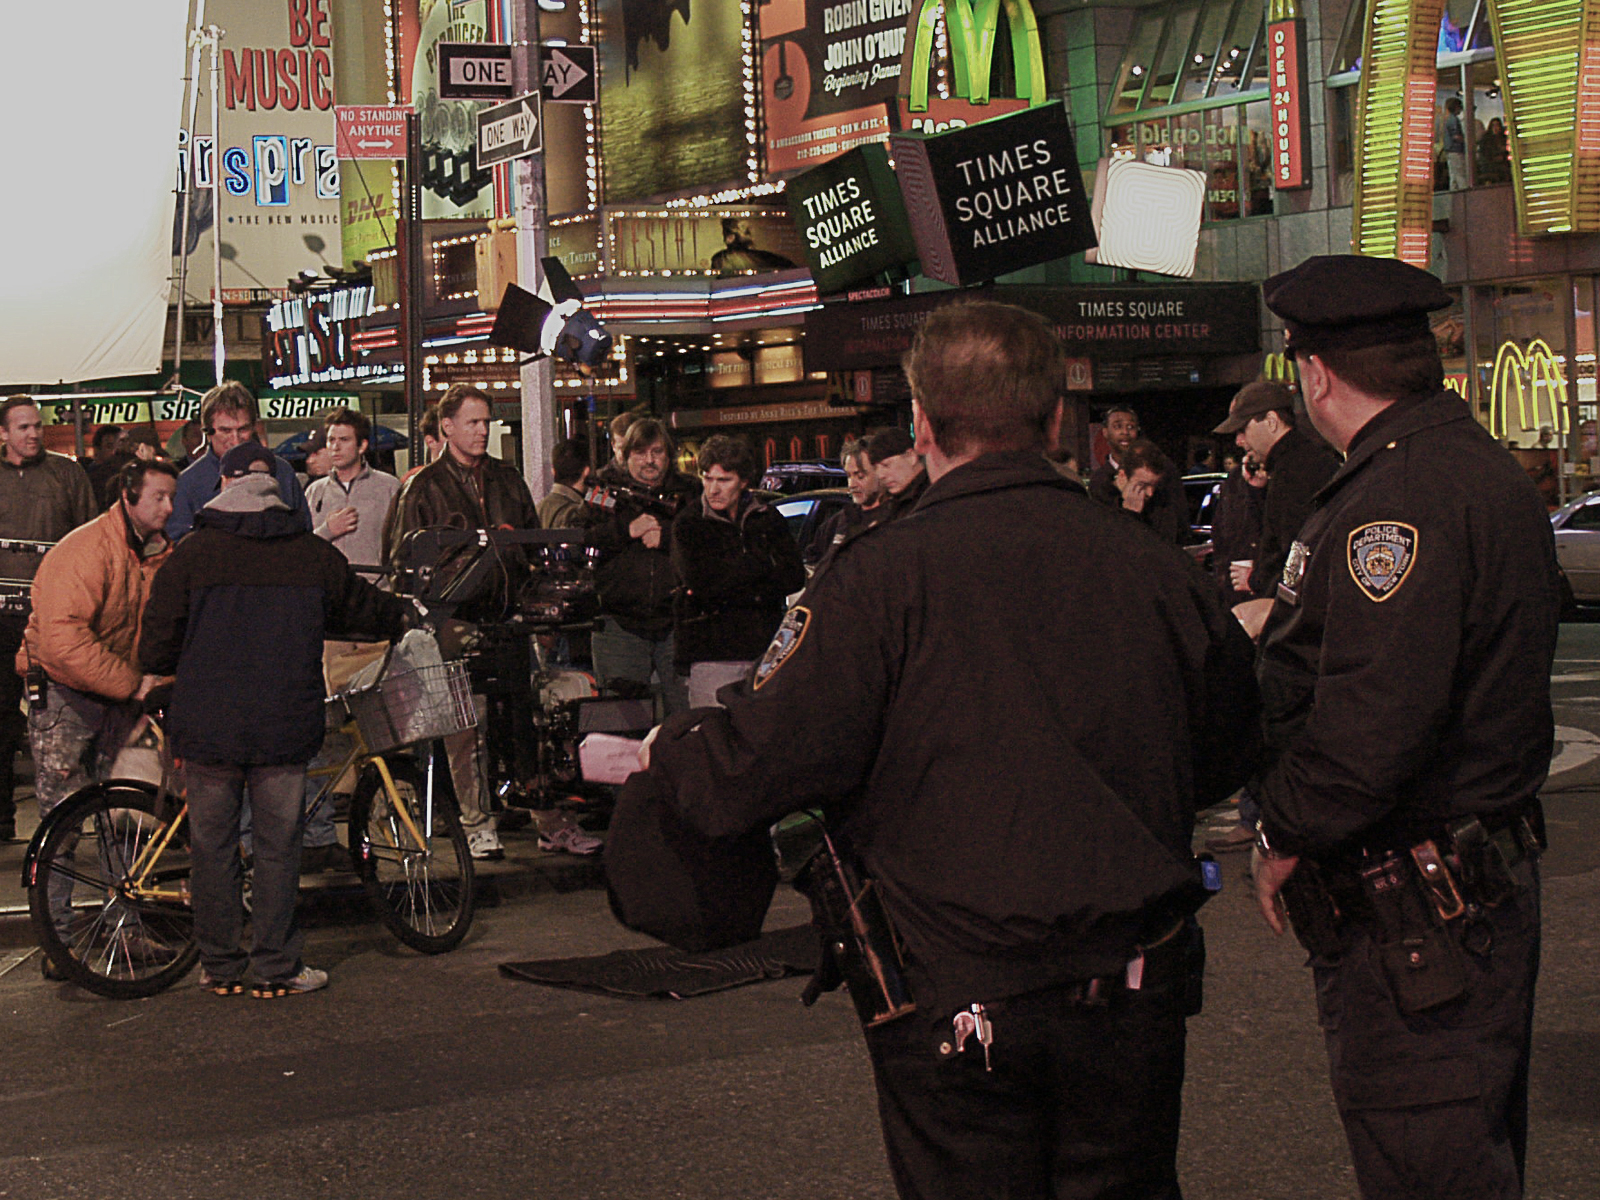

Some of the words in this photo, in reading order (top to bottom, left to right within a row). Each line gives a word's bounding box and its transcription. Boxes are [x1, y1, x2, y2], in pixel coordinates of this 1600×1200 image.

[288, 0, 332, 47] BE
[824, 0, 867, 34] ROBIN
[425, 22, 487, 74] PRODUCER
[824, 37, 863, 71] JOHN
[1274, 30, 1287, 87] OPEN
[222, 47, 333, 112] MUSIC
[463, 60, 506, 83] ONE
[543, 62, 573, 85] AY
[823, 69, 869, 97] Beginning
[1274, 90, 1290, 105] 24
[341, 110, 354, 122] NO
[349, 124, 403, 137] ANYTIME
[487, 122, 505, 148] ONE
[512, 112, 532, 138] WAY
[1277, 108, 1290, 180] HOURS
[956, 139, 1051, 186] TIMES
[802, 177, 860, 220] TIMES
[956, 168, 1071, 222] SQUARE
[238, 215, 260, 226] THE
[268, 215, 292, 225] NEW
[301, 214, 339, 225] MUSIC
[806, 199, 876, 249] SQUARE
[973, 203, 1071, 248] ALLIANCE
[819, 227, 879, 269] ALLIANCE
[861, 315, 891, 331] TIMES
[894, 310, 931, 330] SQUAR
[1078, 302, 1124, 318] TIMES
[1128, 301, 1184, 319] SQUARE
[1155, 323, 1210, 339] CENTER
[52, 402, 139, 425] srro
[1353, 533, 1412, 550] DEPARTMENT
[1364, 526, 1400, 538] POLICE
